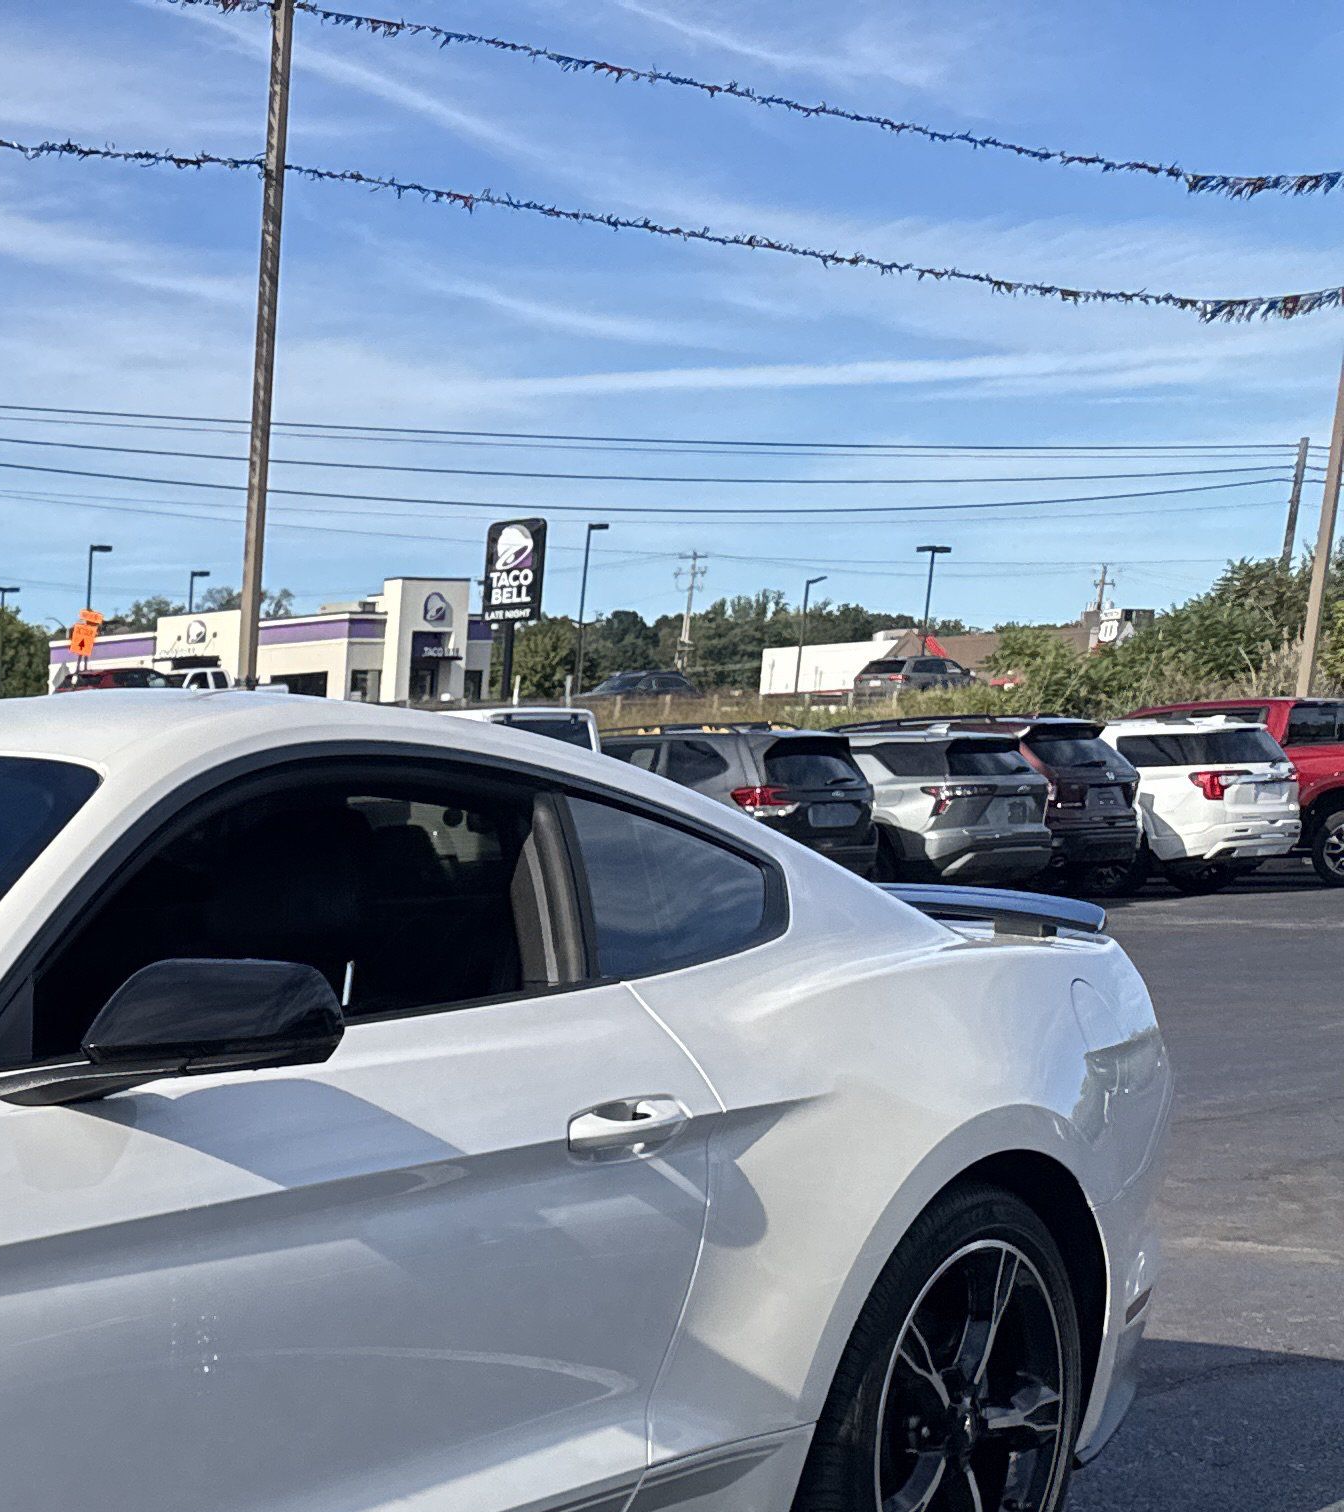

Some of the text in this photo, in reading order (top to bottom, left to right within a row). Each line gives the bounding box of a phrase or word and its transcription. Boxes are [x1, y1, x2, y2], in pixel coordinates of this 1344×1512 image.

[490, 568, 533, 588] TACO
[491, 586, 532, 605] BELL
[484, 608, 531, 620] LATE NIGHT
